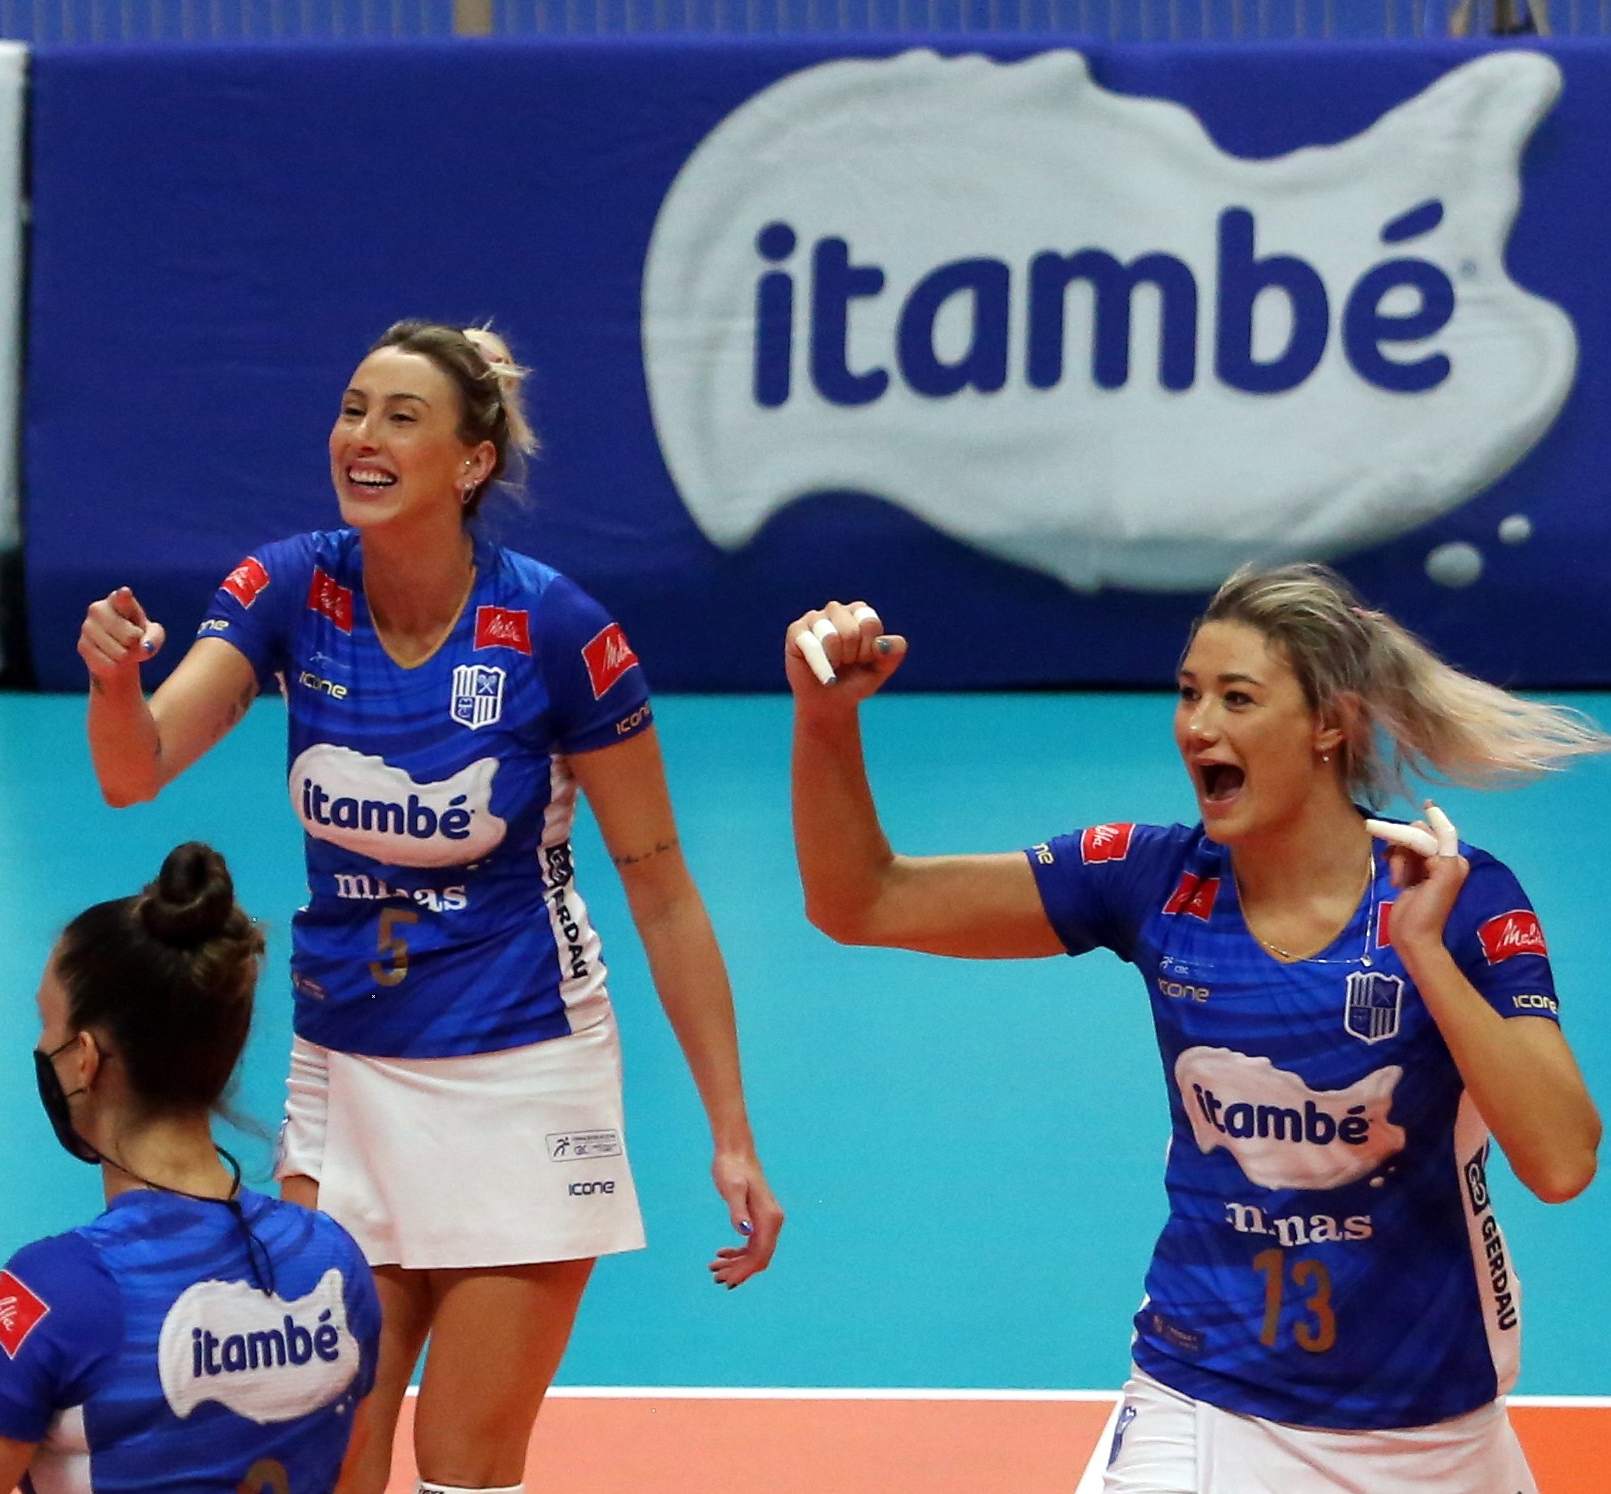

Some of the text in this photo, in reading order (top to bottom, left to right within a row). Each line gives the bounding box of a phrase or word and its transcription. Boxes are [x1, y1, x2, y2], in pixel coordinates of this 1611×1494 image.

[752, 196, 1457, 409] itambé
[302, 778, 472, 840] itambé
[368, 907, 420, 987] 5
[1191, 1083, 1370, 1145] itambé
[1252, 1247, 1337, 1353] 13
[1481, 1215, 1518, 1332] GERDAU
[191, 1309, 340, 1378] itambé
